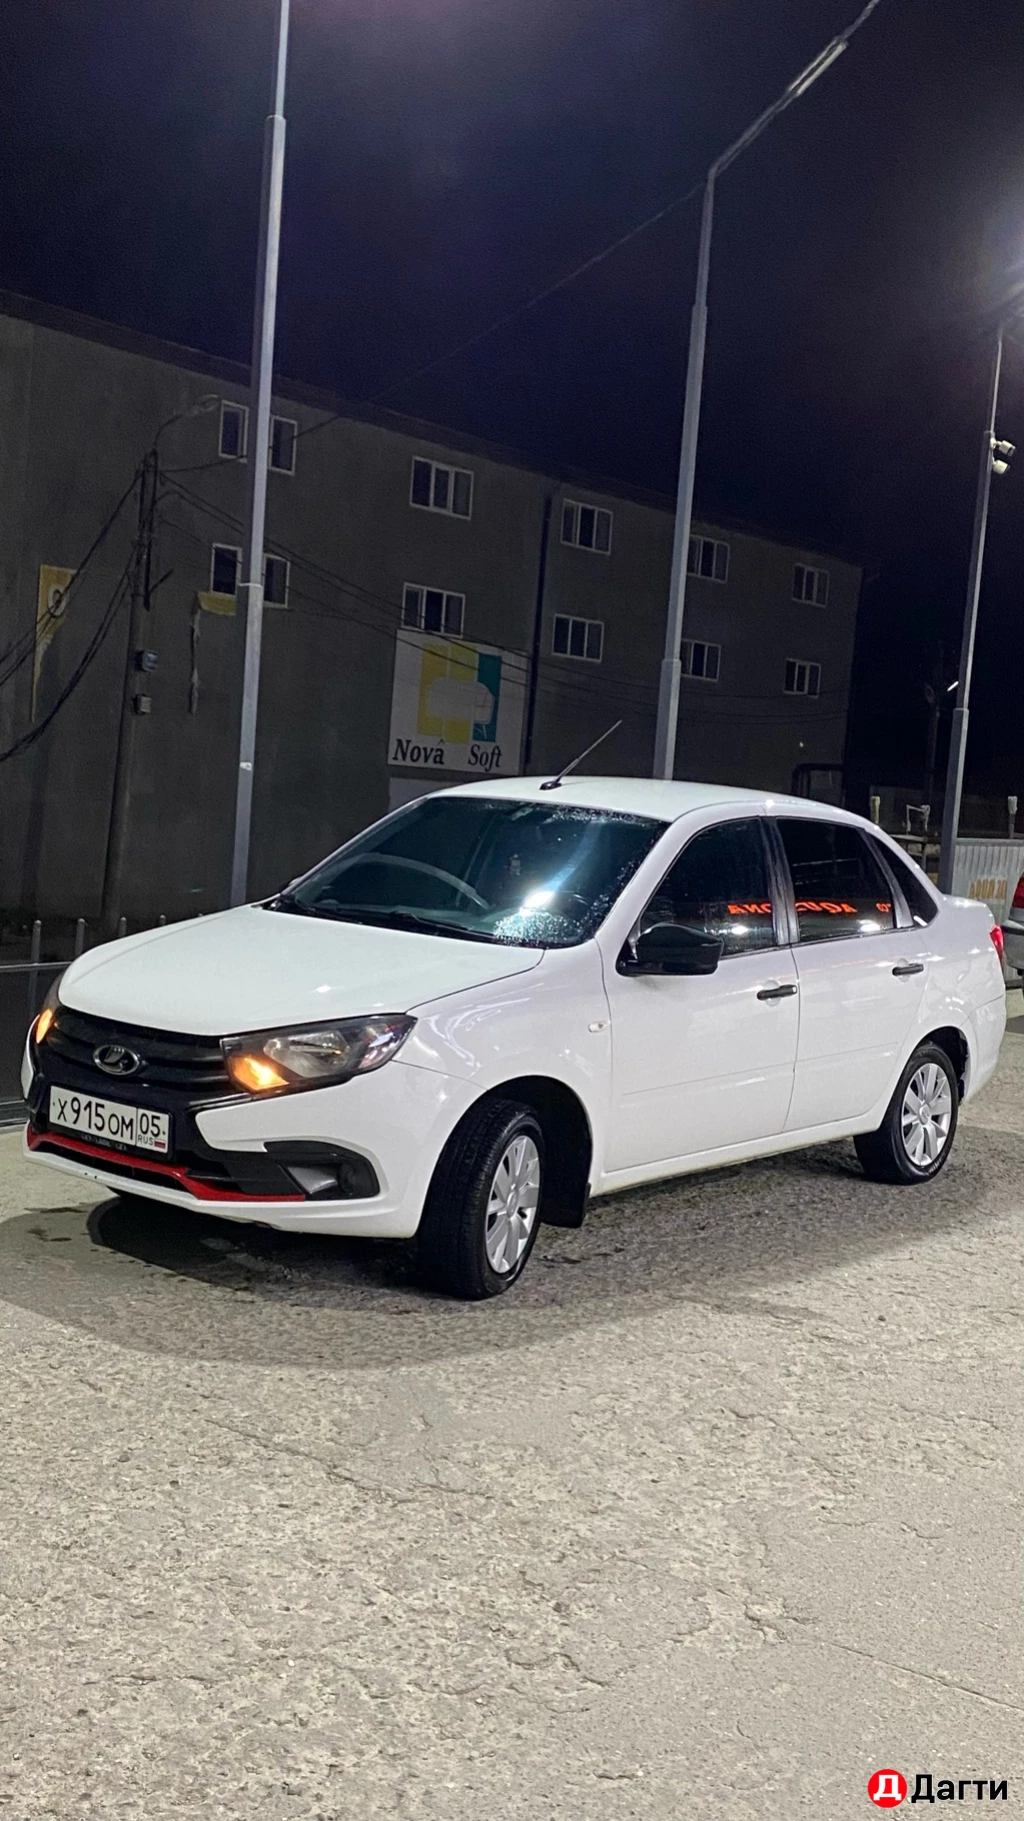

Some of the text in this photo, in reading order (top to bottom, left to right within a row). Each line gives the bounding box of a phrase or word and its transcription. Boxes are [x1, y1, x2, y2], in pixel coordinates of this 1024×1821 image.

[467, 743, 502, 773] Soft
[140, 1112, 161, 1138] 05
[137, 1134, 154, 1146] RUS
